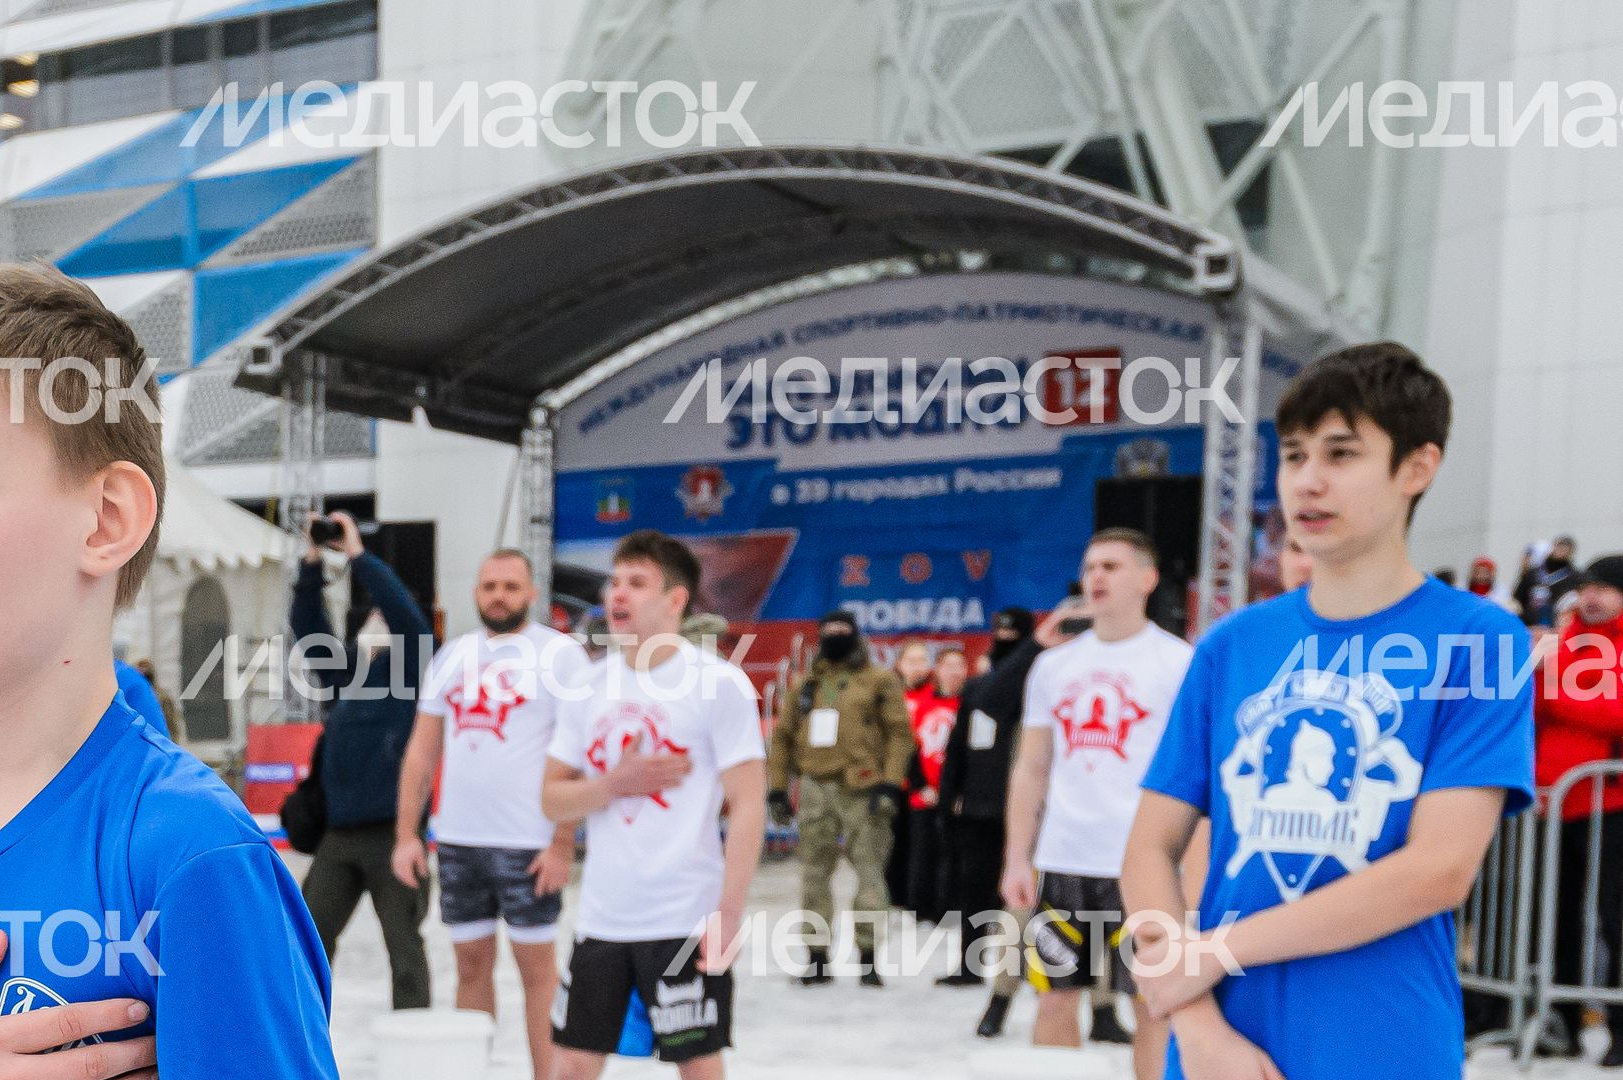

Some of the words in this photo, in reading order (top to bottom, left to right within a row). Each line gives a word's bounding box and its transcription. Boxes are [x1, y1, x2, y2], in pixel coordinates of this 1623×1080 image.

[1053, 366, 1109, 408] 12
[833, 474, 951, 504] городах
[953, 467, 1064, 494] России
[838, 596, 987, 633] ПОБЕДА
